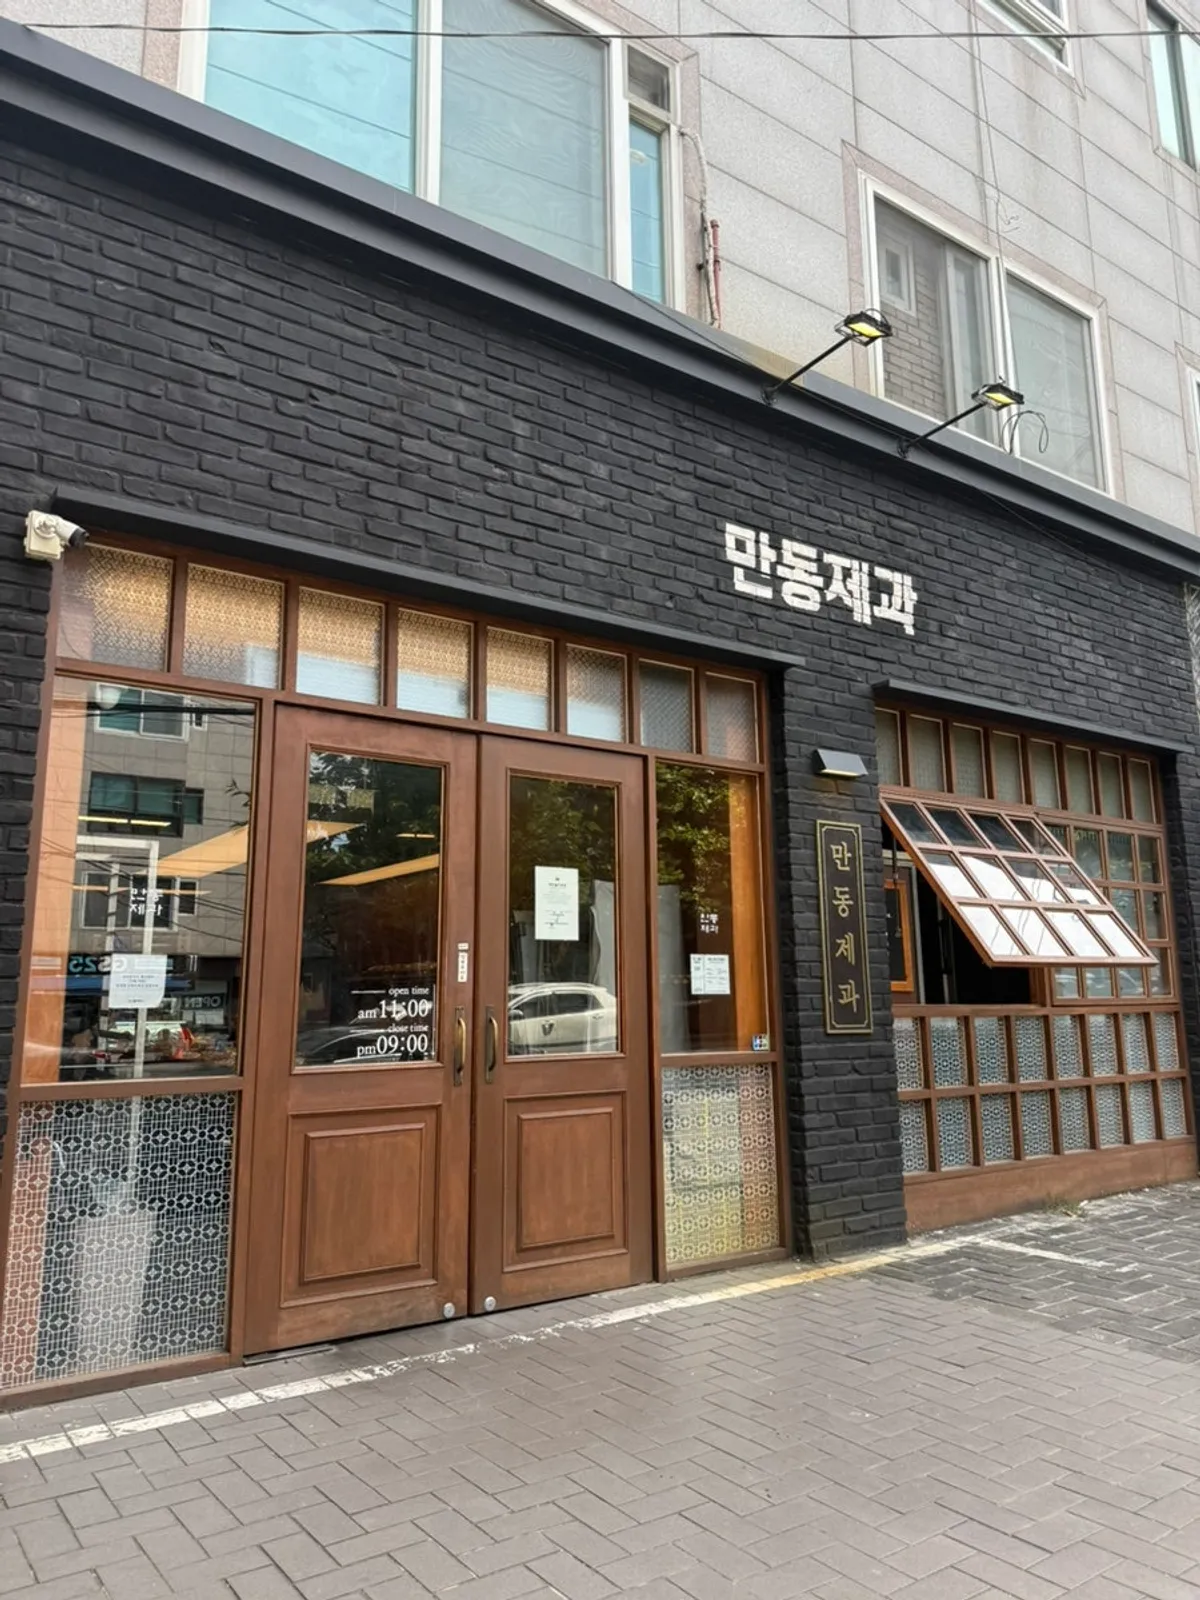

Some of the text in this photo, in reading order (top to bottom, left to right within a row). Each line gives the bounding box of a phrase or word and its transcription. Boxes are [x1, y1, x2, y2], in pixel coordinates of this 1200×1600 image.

[725, 522, 918, 635] 만동제과
[830, 841, 860, 1013] 만동제과
[388, 986, 430, 997] open time
[410, 1023, 429, 1032] time
